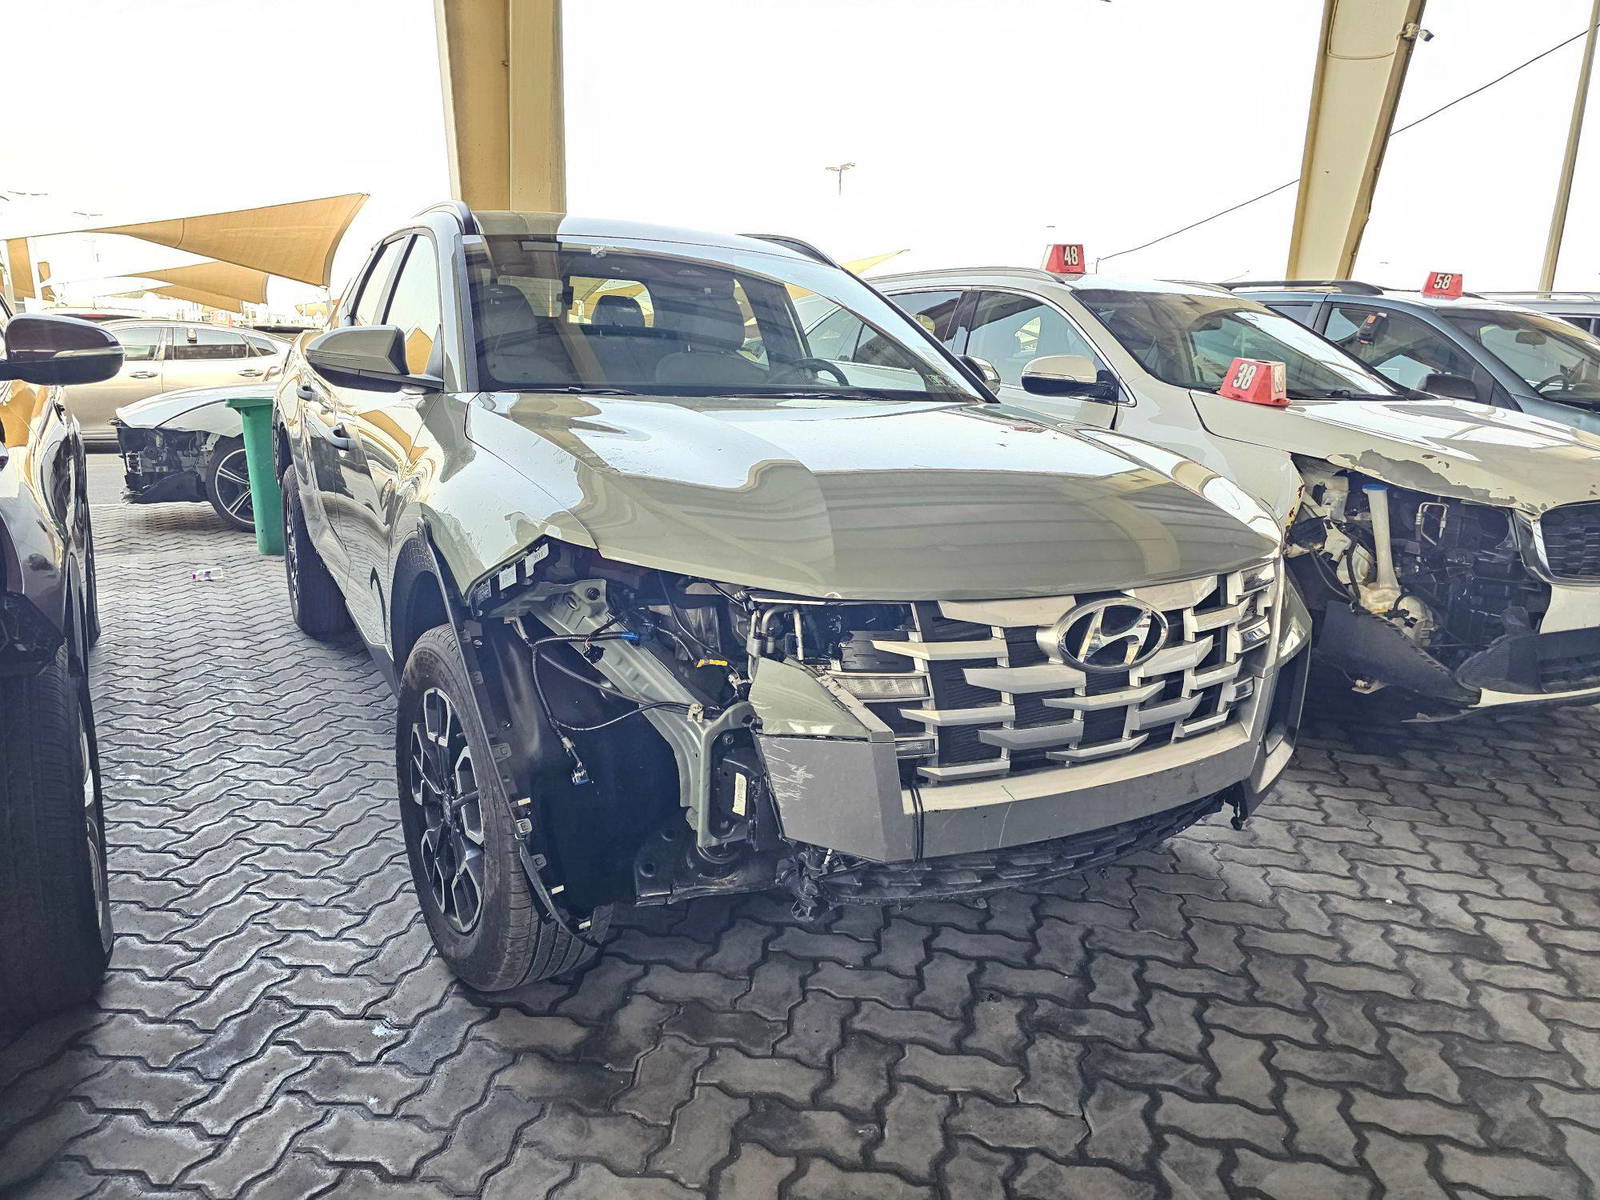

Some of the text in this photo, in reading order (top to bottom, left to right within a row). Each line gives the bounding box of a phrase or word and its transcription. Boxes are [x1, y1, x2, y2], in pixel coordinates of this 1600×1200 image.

[1064, 245, 1079, 265] 48
[1433, 273, 1453, 290] 58
[1232, 363, 1257, 390] 38
